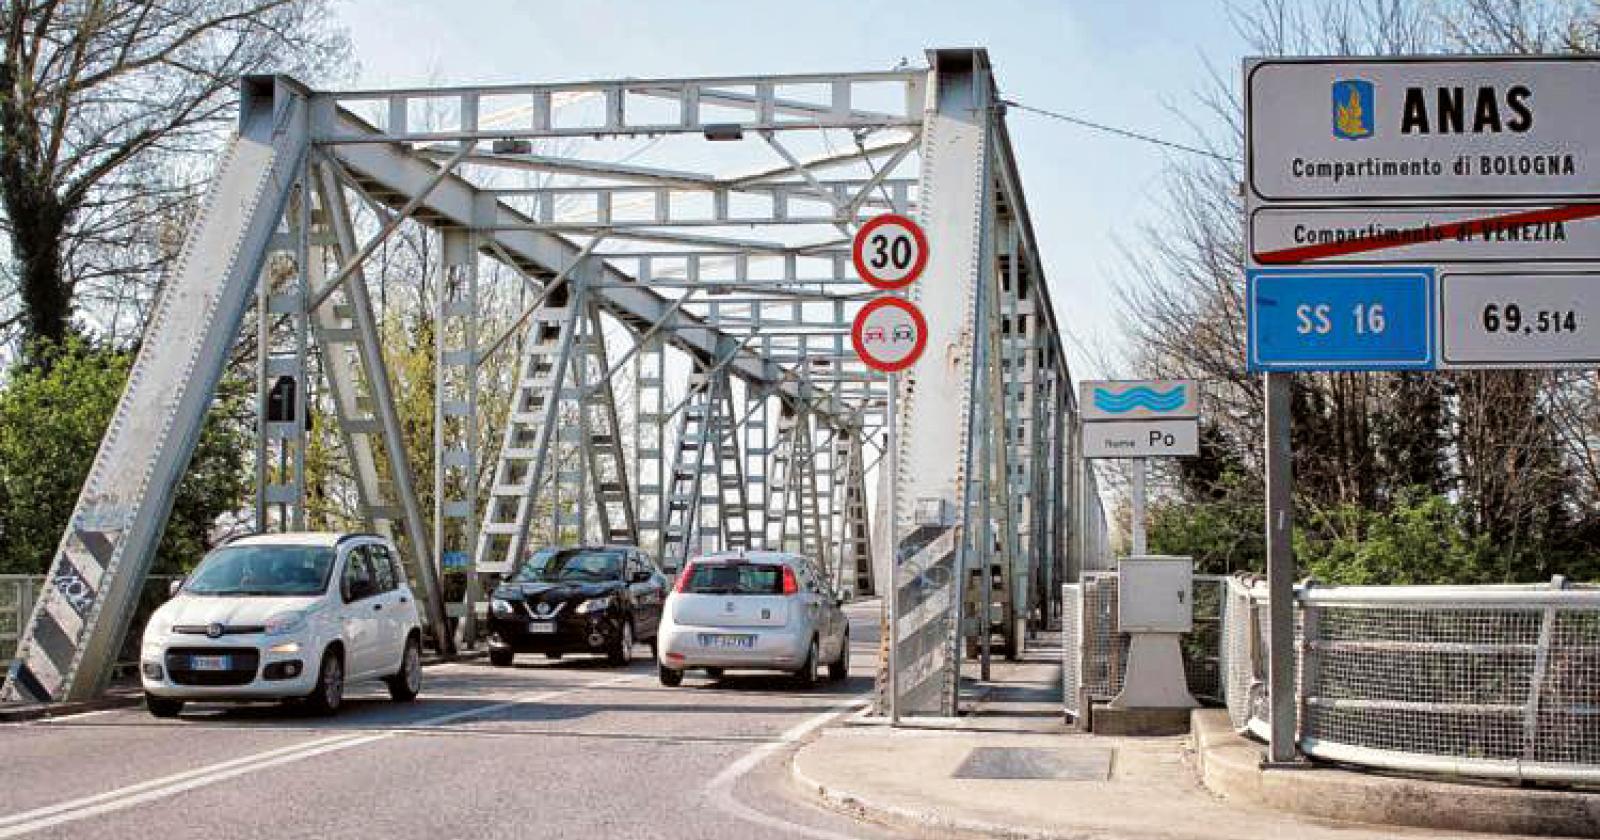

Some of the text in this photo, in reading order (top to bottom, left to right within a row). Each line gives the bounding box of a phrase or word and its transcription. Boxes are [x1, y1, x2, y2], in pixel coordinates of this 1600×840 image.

[1402, 86, 1533, 134] ANAS
[1292, 155, 1575, 182] Compartimento di BOLOGNA
[1483, 221, 1566, 242] VENEZIA
[870, 234, 912, 270] 30
[1296, 304, 1386, 334] SS 16
[1484, 303, 1577, 335] 69.514
[1149, 430, 1175, 447] Po
